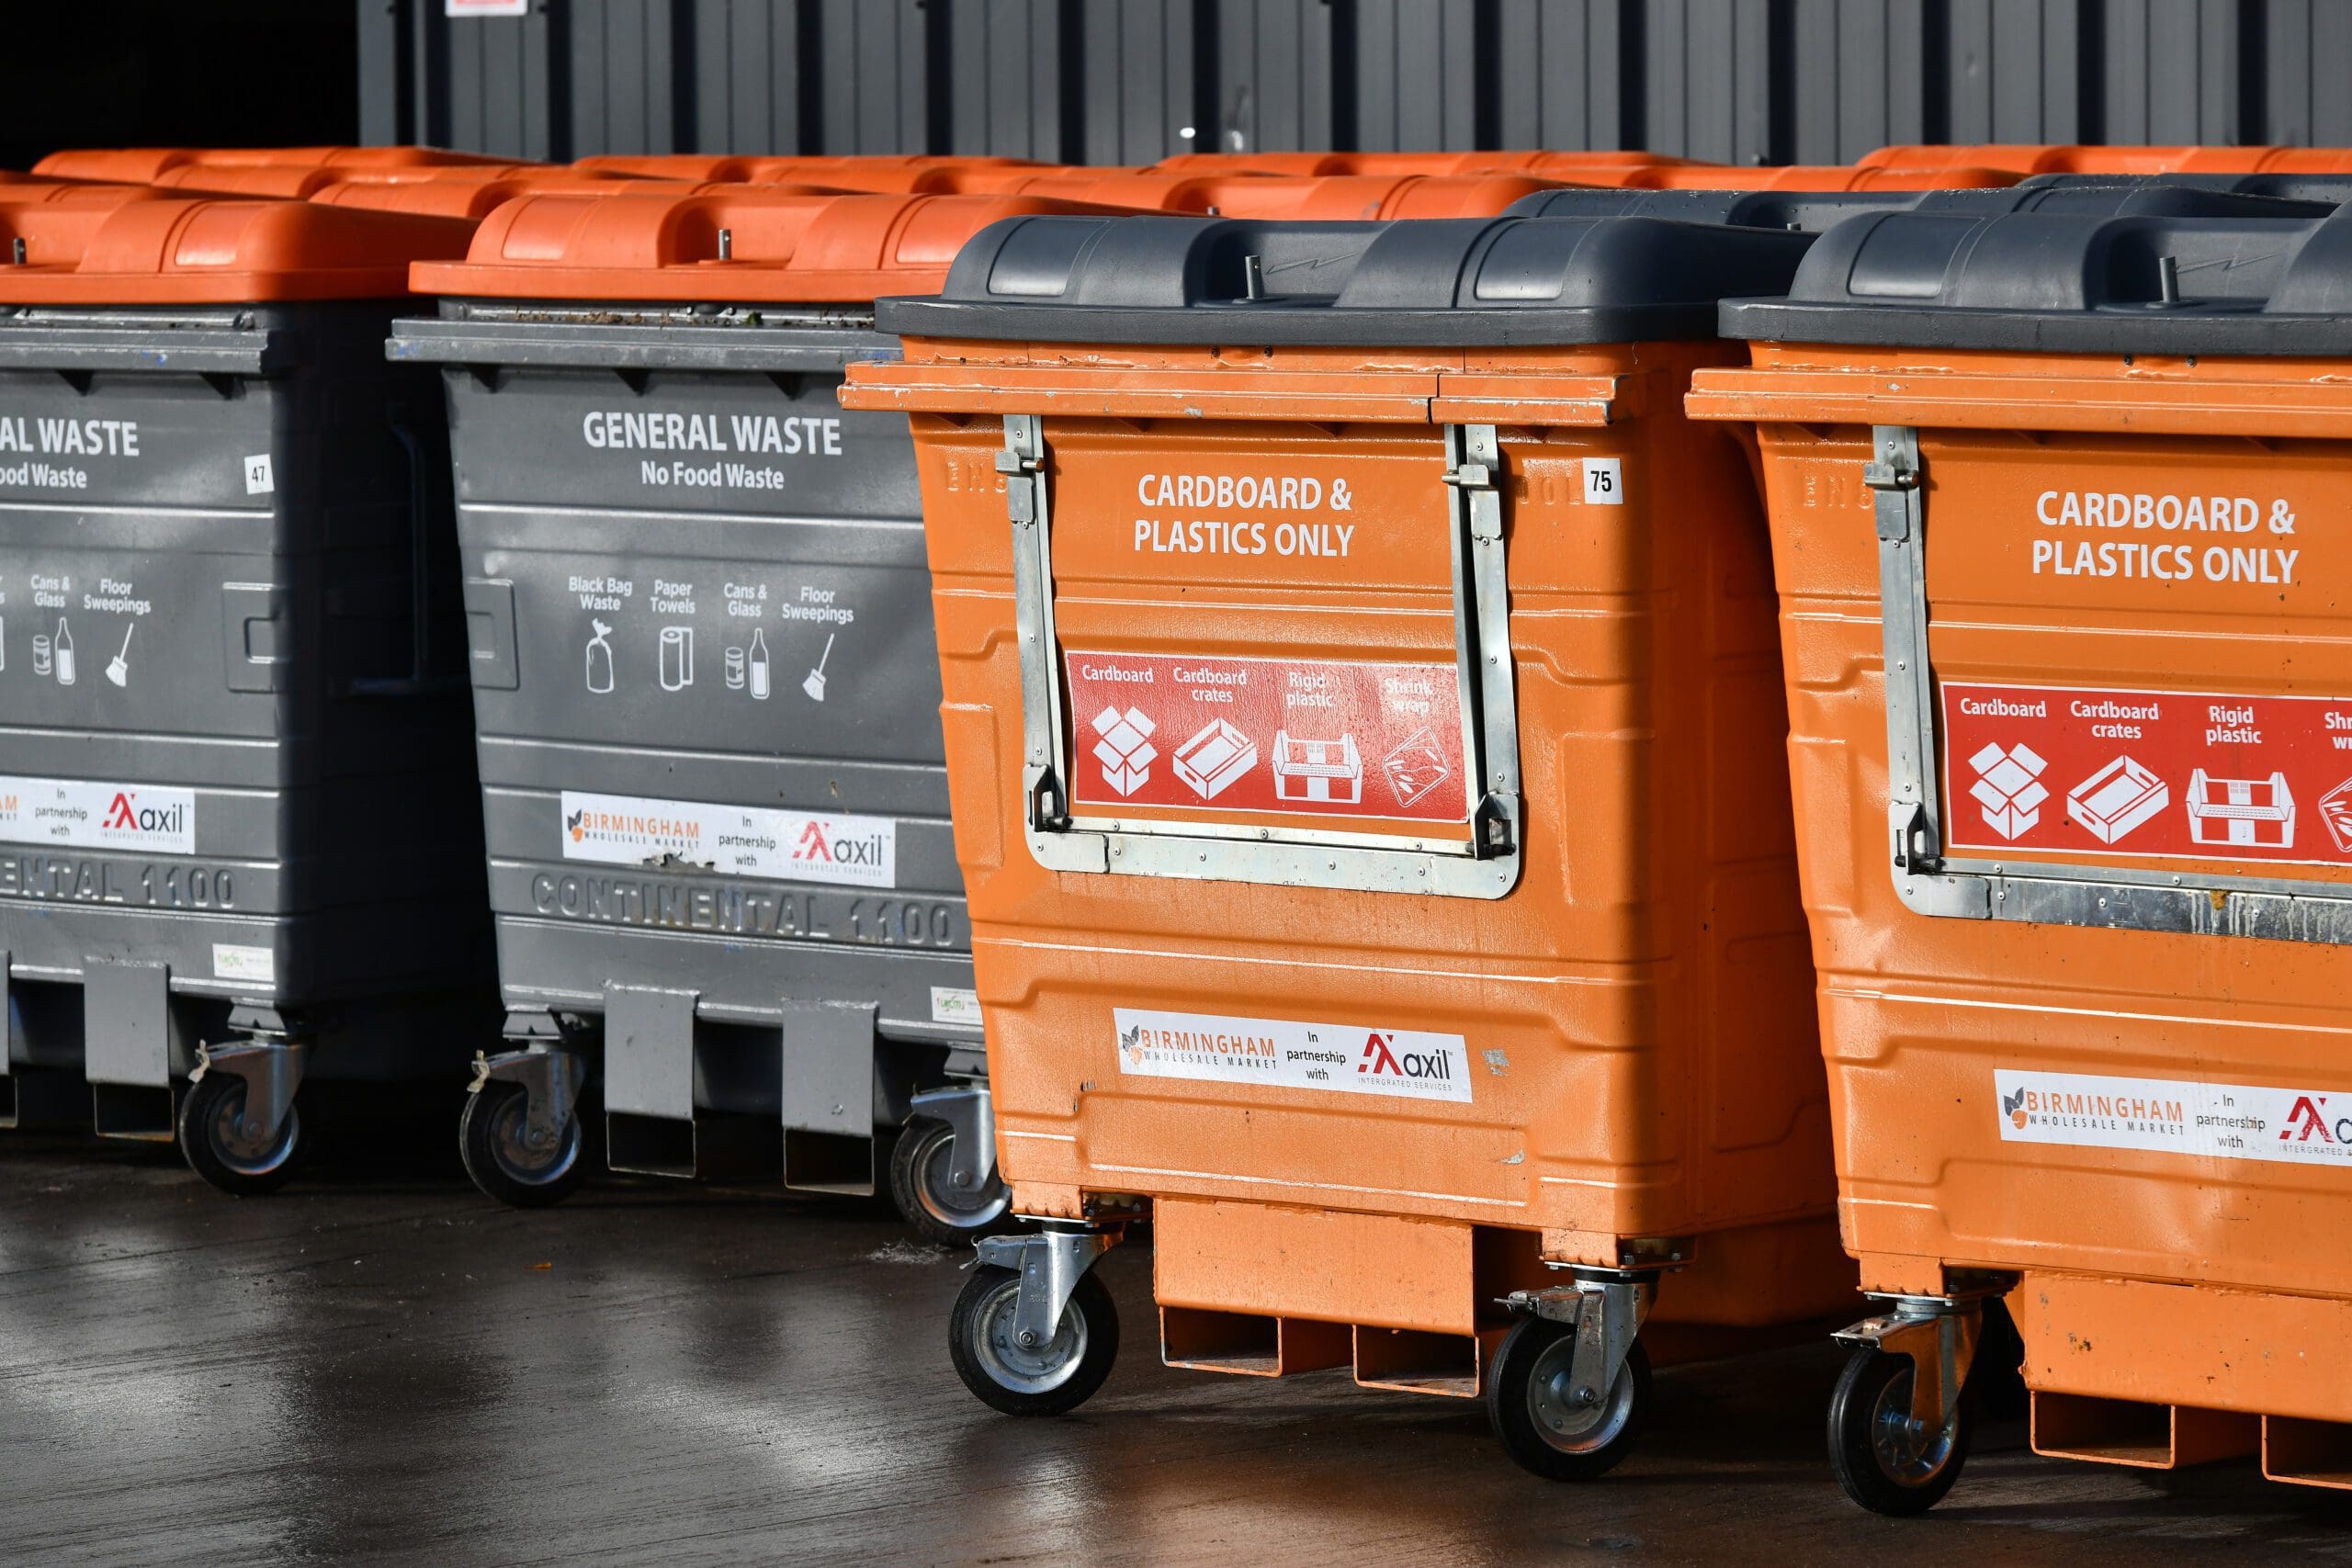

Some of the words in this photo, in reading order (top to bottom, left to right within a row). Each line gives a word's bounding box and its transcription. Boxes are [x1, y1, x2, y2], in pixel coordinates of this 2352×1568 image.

[38, 418, 140, 456] WASTE
[583, 412, 727, 451] GENERAL
[731, 415, 842, 456] WASTE
[31, 463, 87, 489] Waste
[252, 466, 266, 482] 47
[641, 461, 669, 485] No
[673, 462, 721, 487] Food
[726, 464, 784, 490] Waste
[1590, 470, 1611, 492] 75
[1137, 474, 1322, 510] CARDBOARD
[1329, 479, 1352, 511] &
[2036, 491, 2259, 533] CARDBOARD
[2268, 499, 2296, 535] &
[1135, 520, 1267, 554] PLASTICS
[1274, 523, 1354, 557] ONLY
[2032, 539, 2194, 581] PLASTICS
[2203, 547, 2300, 584] ONLY
[30, 574, 59, 590] Cans
[62, 576, 70, 592] &
[100, 578, 132, 595] Floor
[569, 576, 605, 593] Black
[606, 578, 632, 596] Bag
[654, 579, 693, 598] Paper
[724, 582, 754, 600] Cans
[758, 584, 767, 600] &
[34, 591, 66, 608] Glass
[580, 594, 620, 610] Waste
[800, 587, 835, 604] Floor
[84, 595, 151, 615] Sweepings
[650, 597, 695, 615] Towels
[728, 601, 762, 617] Glass
[782, 603, 854, 624] Sweepings
[1082, 664, 1154, 682] Cardboard
[1173, 667, 1247, 685] Cardboard
[1289, 672, 1326, 690] Rigid
[1193, 688, 1233, 703] crates
[1385, 677, 1433, 696] Shrink
[1286, 691, 1333, 707] plastic
[1393, 700, 1430, 716] wrap
[1960, 697, 2047, 718] Cardboard
[2070, 700, 2159, 720] Cardboard
[2209, 705, 2255, 728] Rigid
[2091, 723, 2143, 739] crates
[2206, 725, 2263, 746] plastic
[57, 787, 65, 799] In
[35, 807, 87, 822] partnership
[140, 803, 183, 833] axil
[742, 816, 752, 828] In
[51, 825, 70, 837] with
[583, 812, 699, 839] BIRMINGHAM
[655, 838, 699, 849] MARKET
[718, 834, 776, 852] partnership
[834, 835, 882, 866] axil
[735, 853, 756, 866] with
[141, 865, 235, 908] 1100
[532, 874, 830, 937] CONTINENTAL
[850, 899, 952, 946] 1100
[1140, 1029, 1275, 1057] BIRMINGHAM
[1307, 1032, 1318, 1043] In
[1144, 1051, 1218, 1066] WHOLESALE
[1227, 1056, 1277, 1069] MARKET
[1287, 1050, 1346, 1066] partnership
[1403, 1049, 1450, 1080] axil
[1306, 1067, 1329, 1081] with
[1414, 1081, 1453, 1091] SERVICES
[2026, 1090, 2183, 1122] BIRMINGHAM
[2222, 1094, 2234, 1107] In
[2029, 1114, 2117, 1130] WHOLESALE
[2128, 1121, 2184, 1135] MARKET
[2197, 1114, 2266, 1133] partnership
[2218, 1135, 2244, 1148] with
